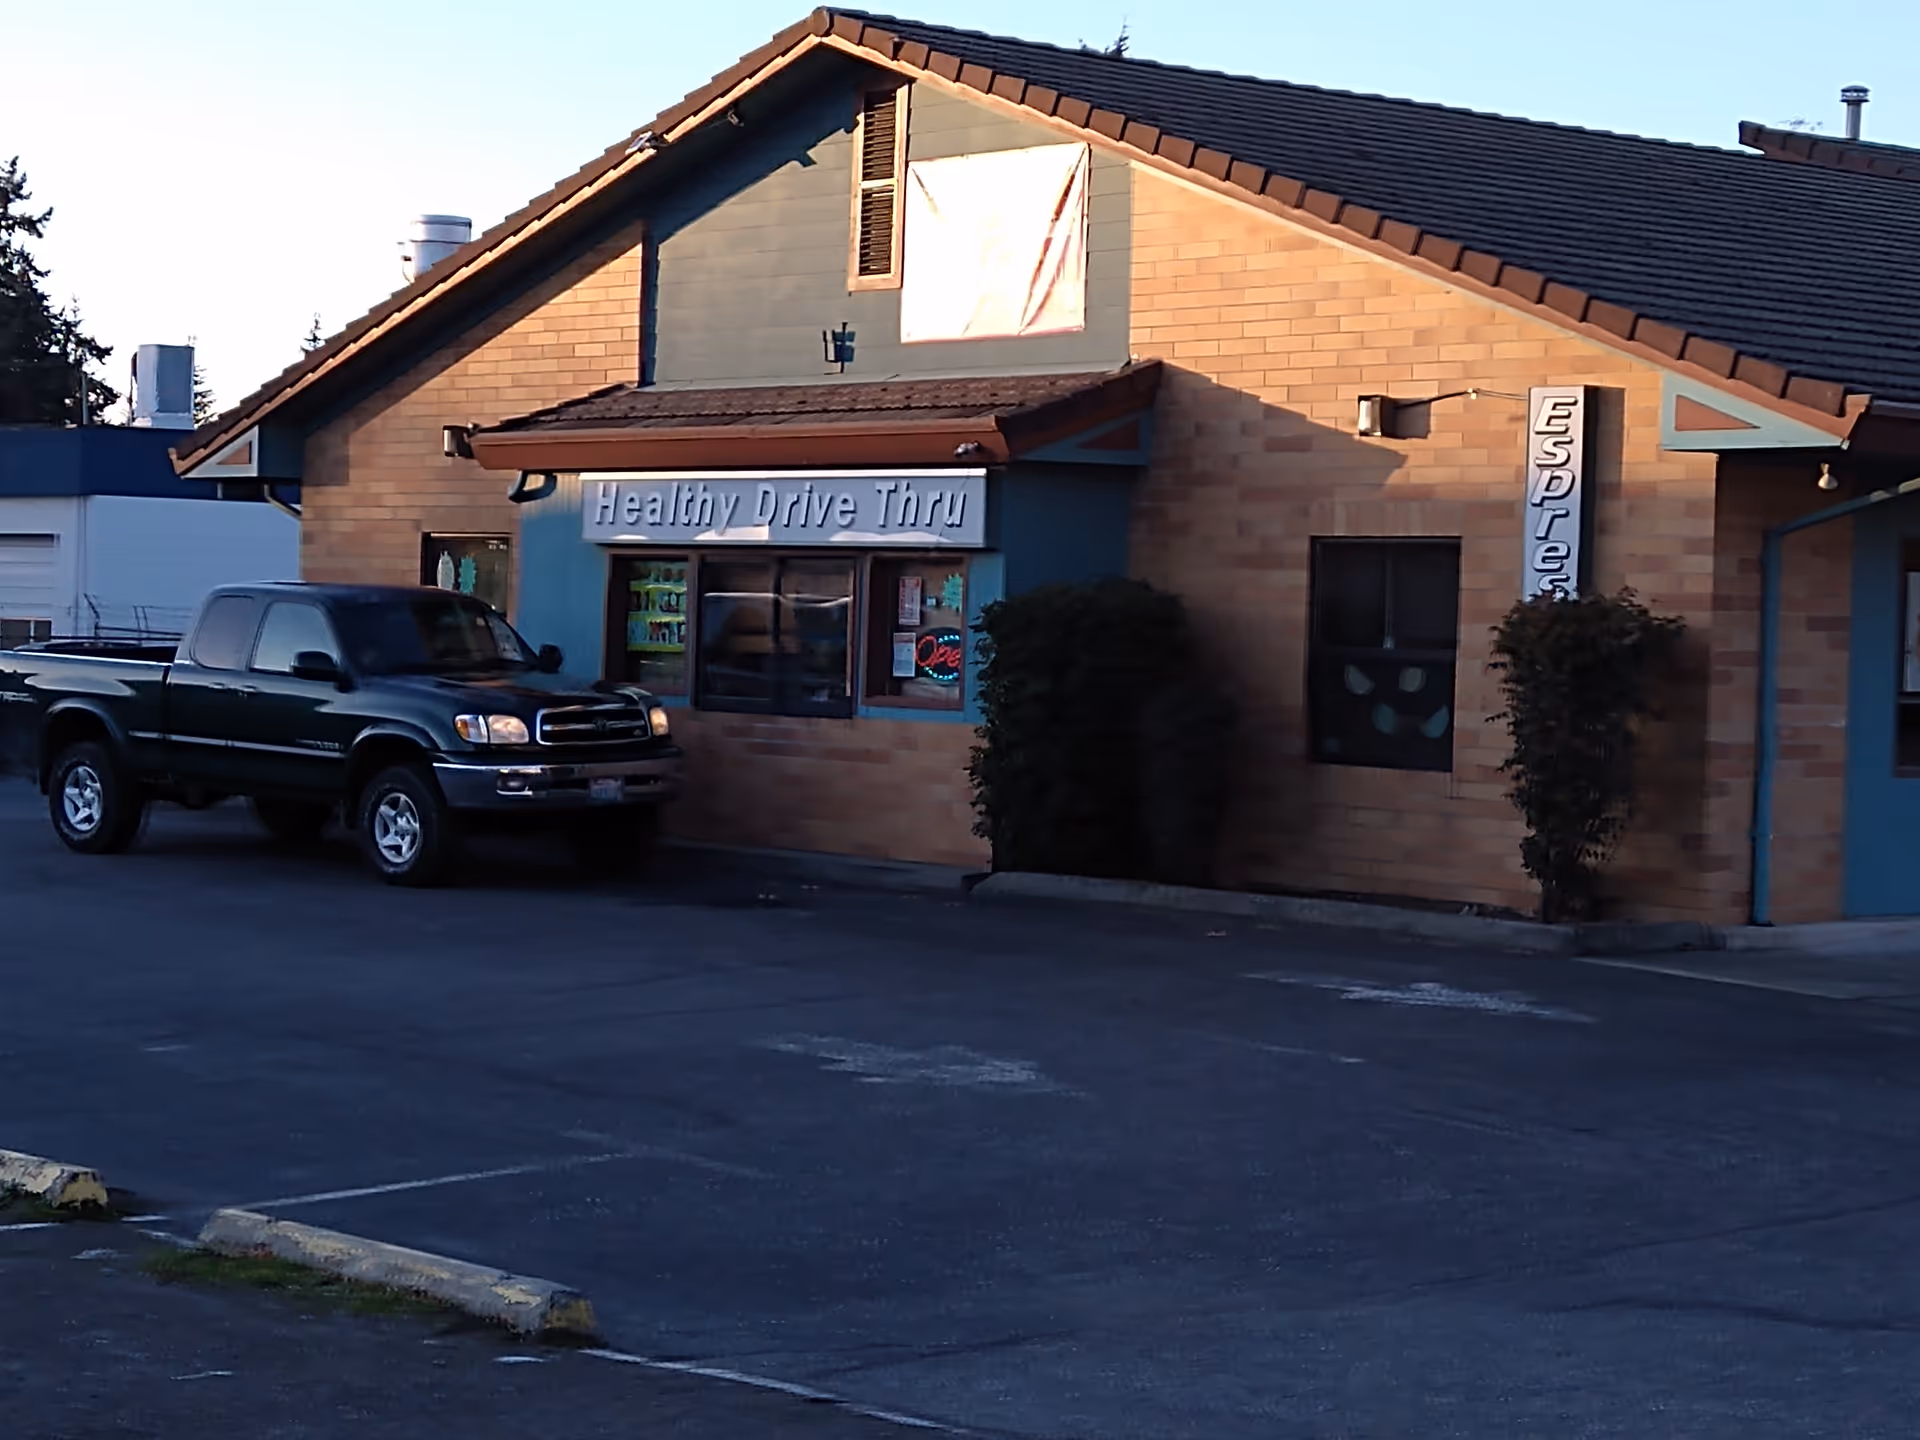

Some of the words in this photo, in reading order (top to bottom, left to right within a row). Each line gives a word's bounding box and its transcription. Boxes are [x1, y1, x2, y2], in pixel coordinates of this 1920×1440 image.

[595, 482, 740, 536] Healthy
[753, 482, 857, 528] Drive
[875, 481, 967, 528] Thru
